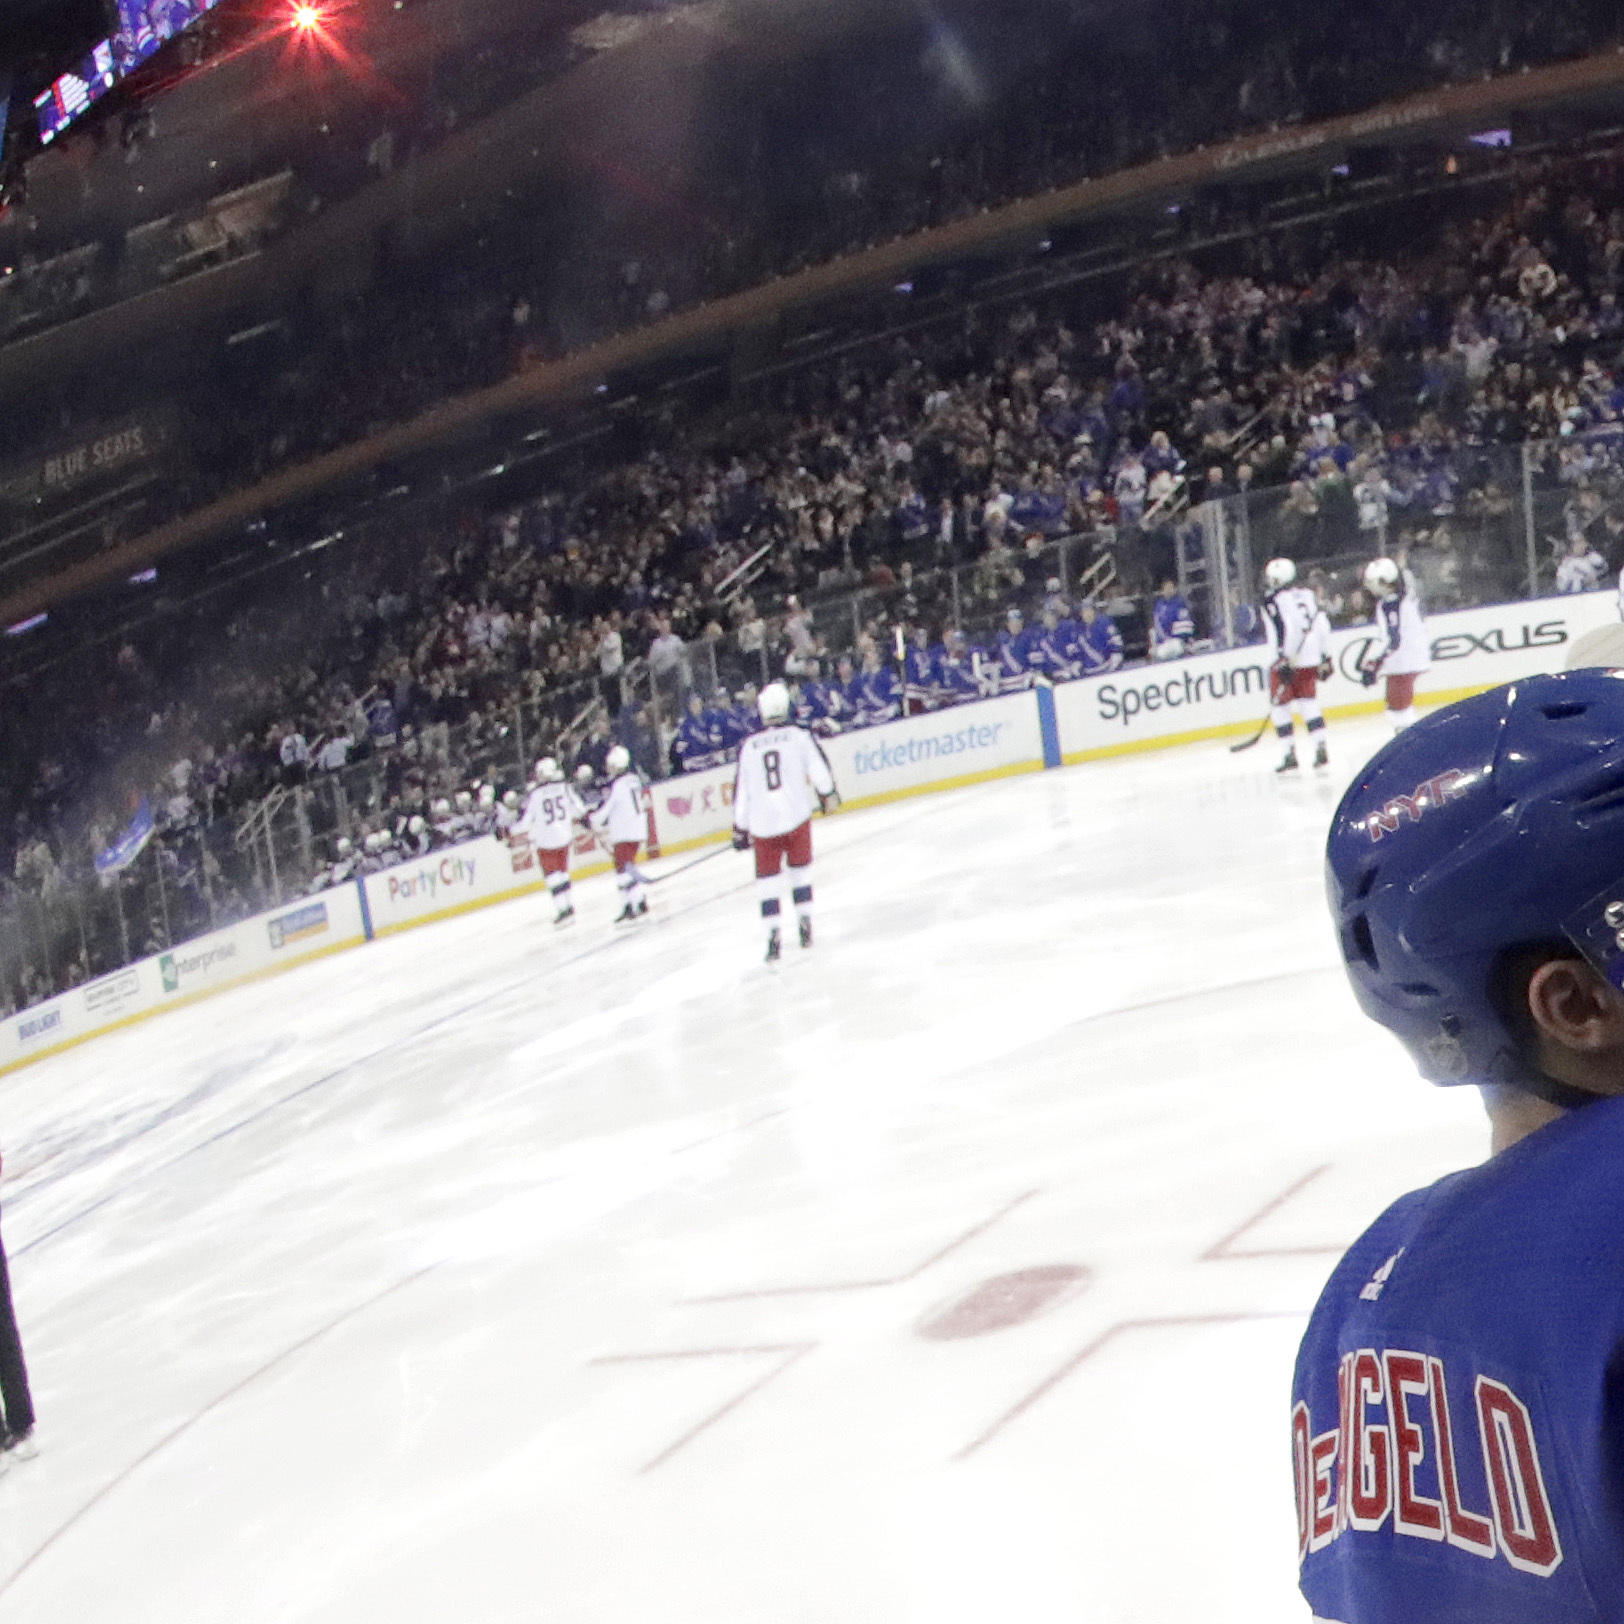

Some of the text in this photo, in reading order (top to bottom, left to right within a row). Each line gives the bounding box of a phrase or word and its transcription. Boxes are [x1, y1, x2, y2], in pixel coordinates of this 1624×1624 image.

[1428, 619, 1568, 661] EXUS
[1097, 662, 1264, 725] Spectrum
[763, 750, 782, 791] 8
[853, 720, 1004, 776] ticketmaster
[542, 795, 567, 826] 95
[1366, 767, 1468, 843] NYR
